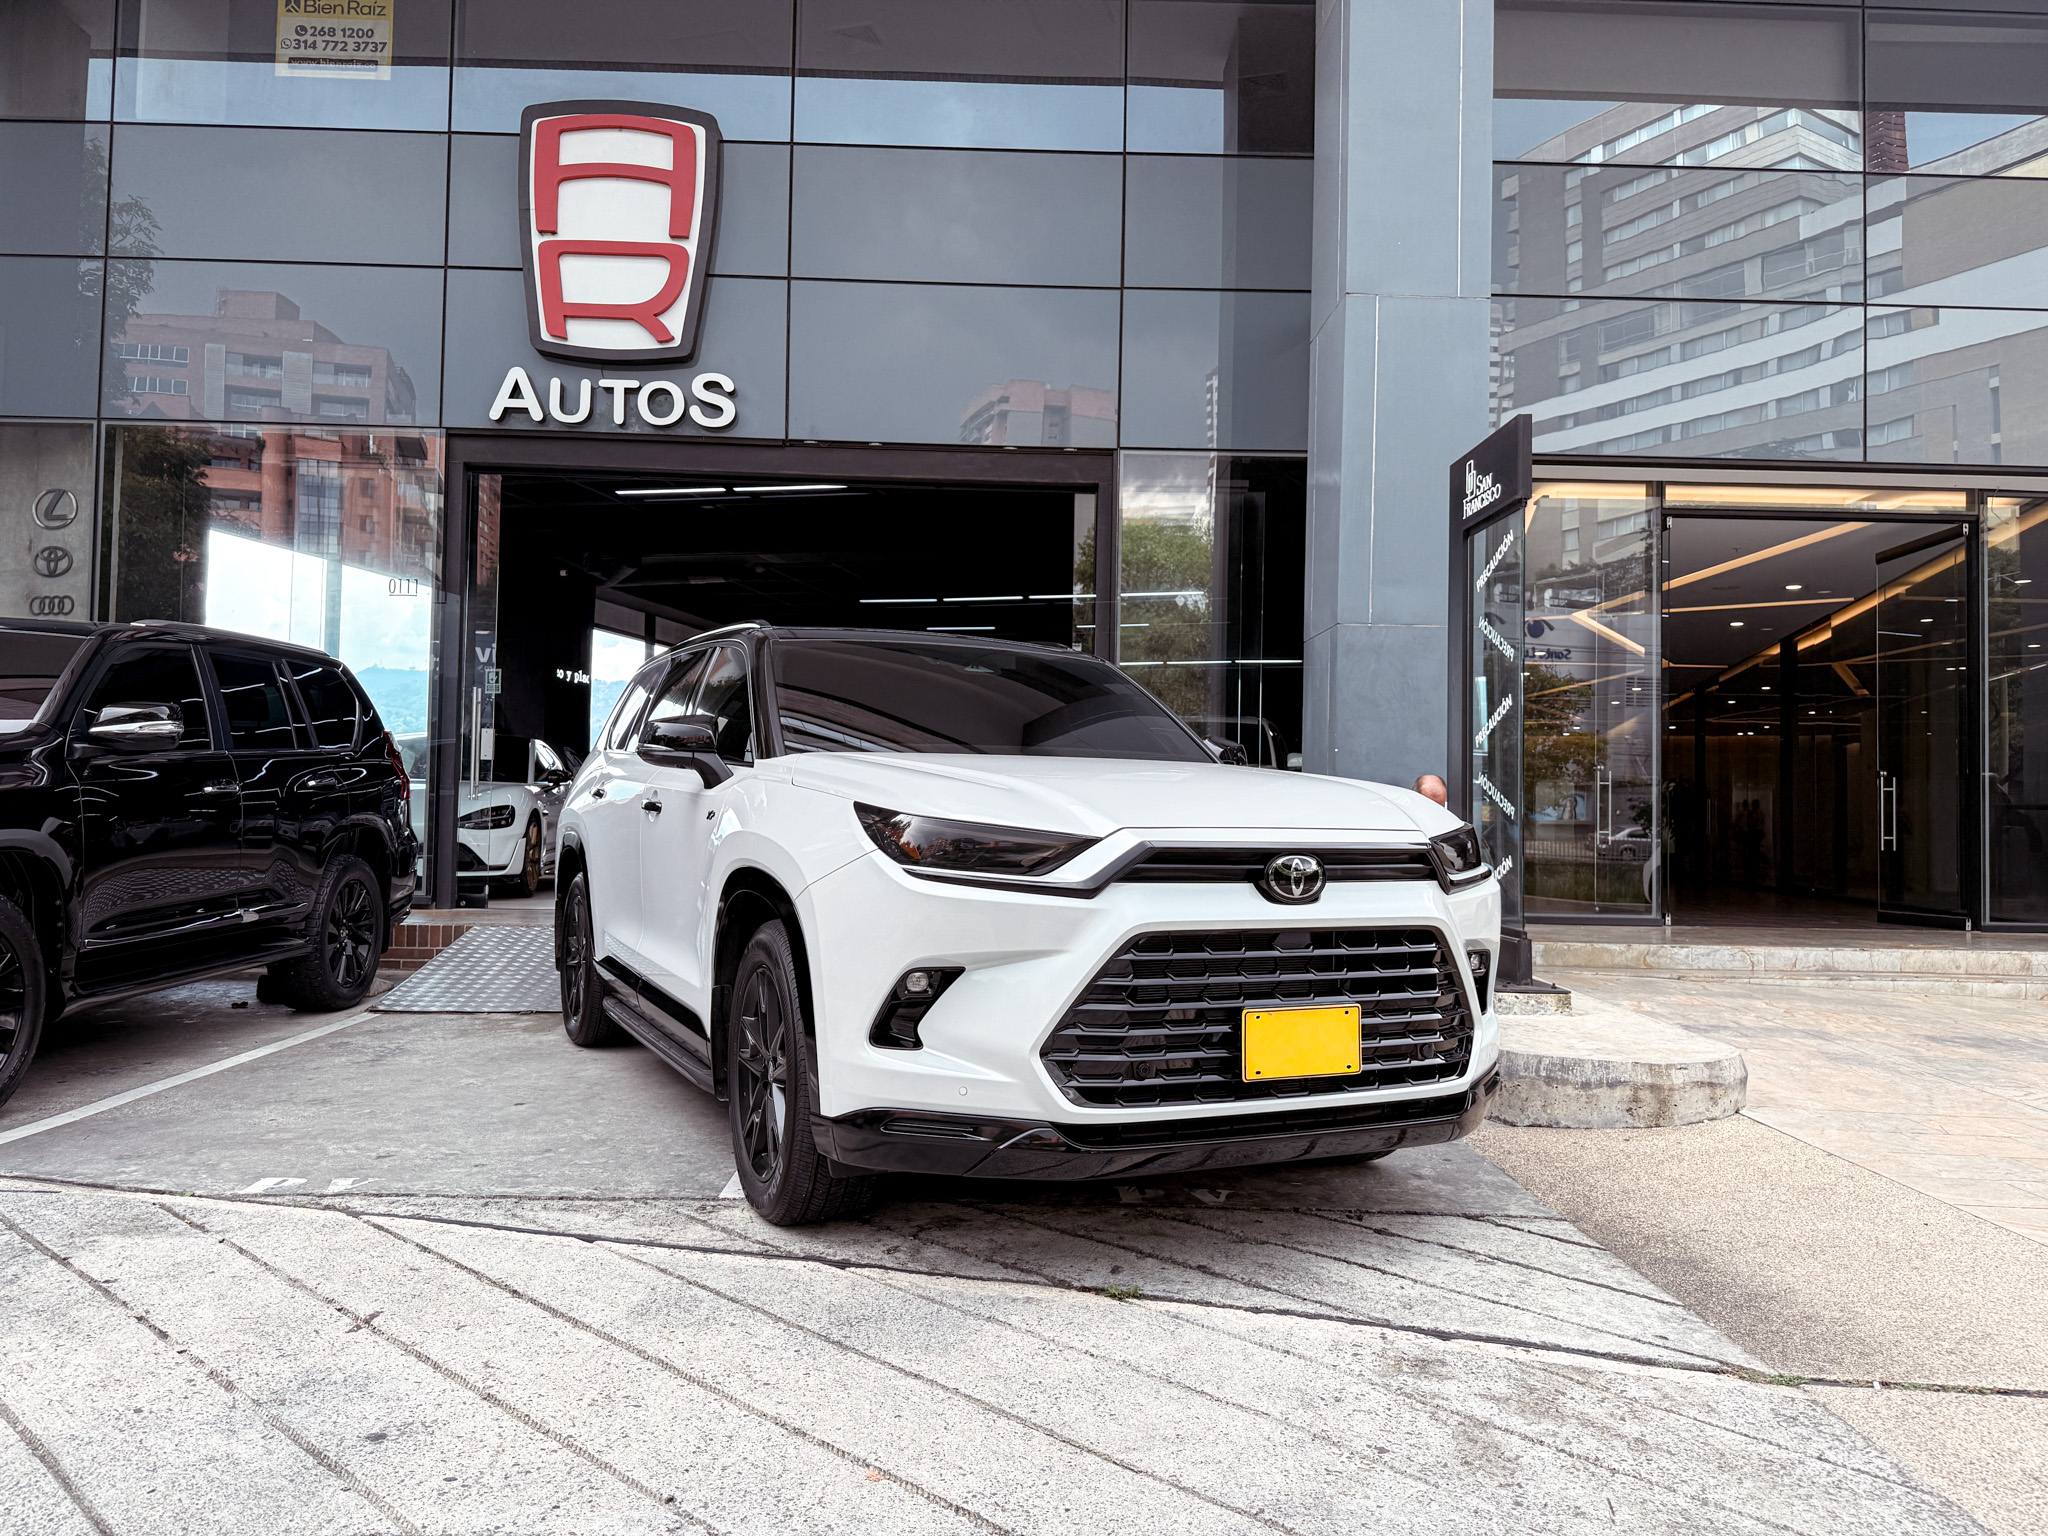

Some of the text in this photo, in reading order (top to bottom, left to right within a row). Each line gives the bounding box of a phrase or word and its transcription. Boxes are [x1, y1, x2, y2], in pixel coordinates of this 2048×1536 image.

[303, 0, 387, 17] Bien Raíz
[309, 26, 375, 38] 268 1200
[292, 39, 388, 53] 314 772 3737
[1476, 473, 1493, 496] SAN
[1462, 484, 1502, 520] FRANCISCO
[1475, 529, 1514, 593] PRECAUCIÓN
[1474, 693, 1513, 748] PRECAUCIÓN
